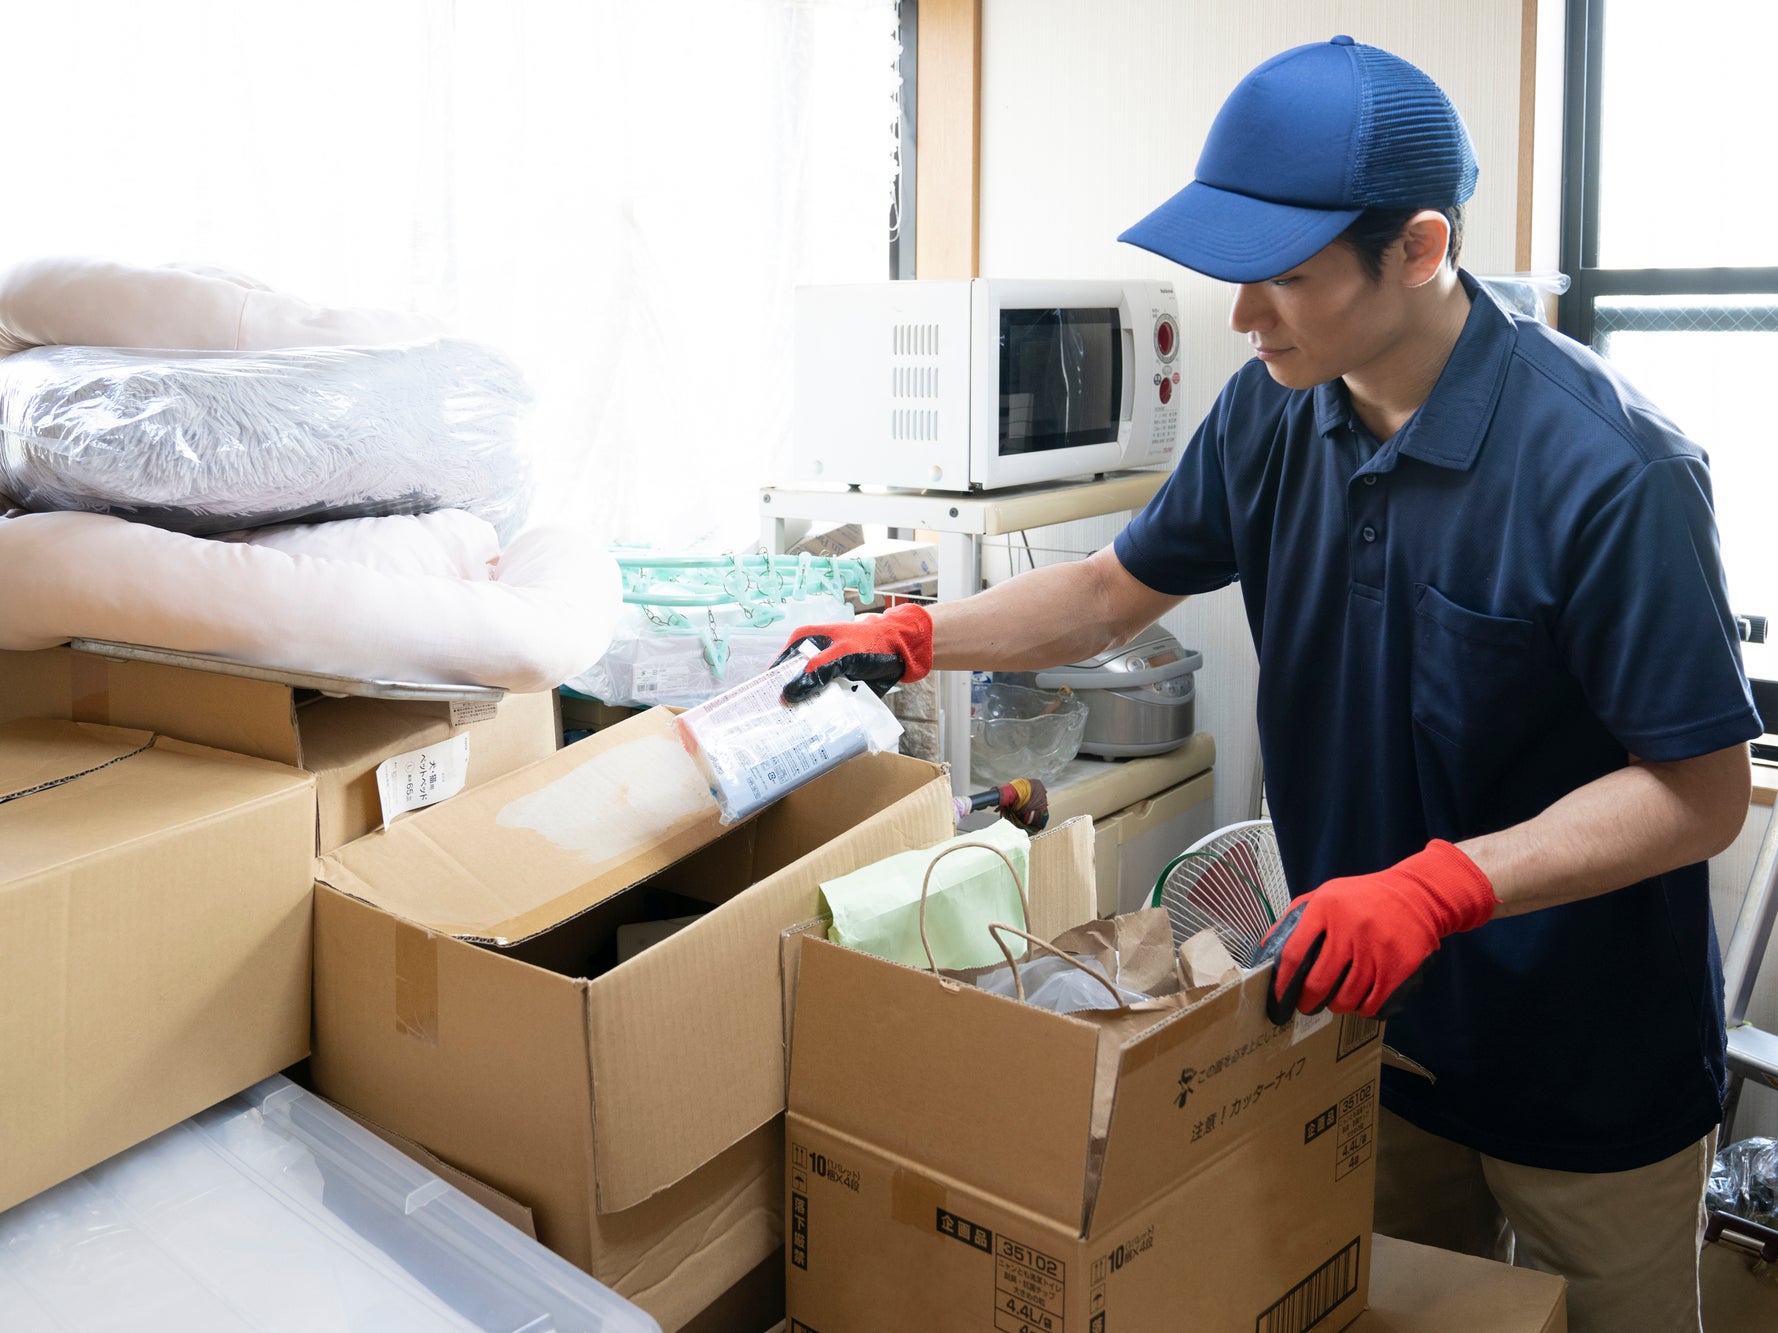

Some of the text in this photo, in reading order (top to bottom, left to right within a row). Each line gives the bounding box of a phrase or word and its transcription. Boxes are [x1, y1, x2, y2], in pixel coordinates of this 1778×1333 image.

[1342, 1086, 1371, 1113] 35102
[940, 1213, 989, 1250] 企画品
[1002, 1240, 1058, 1277] 35102
